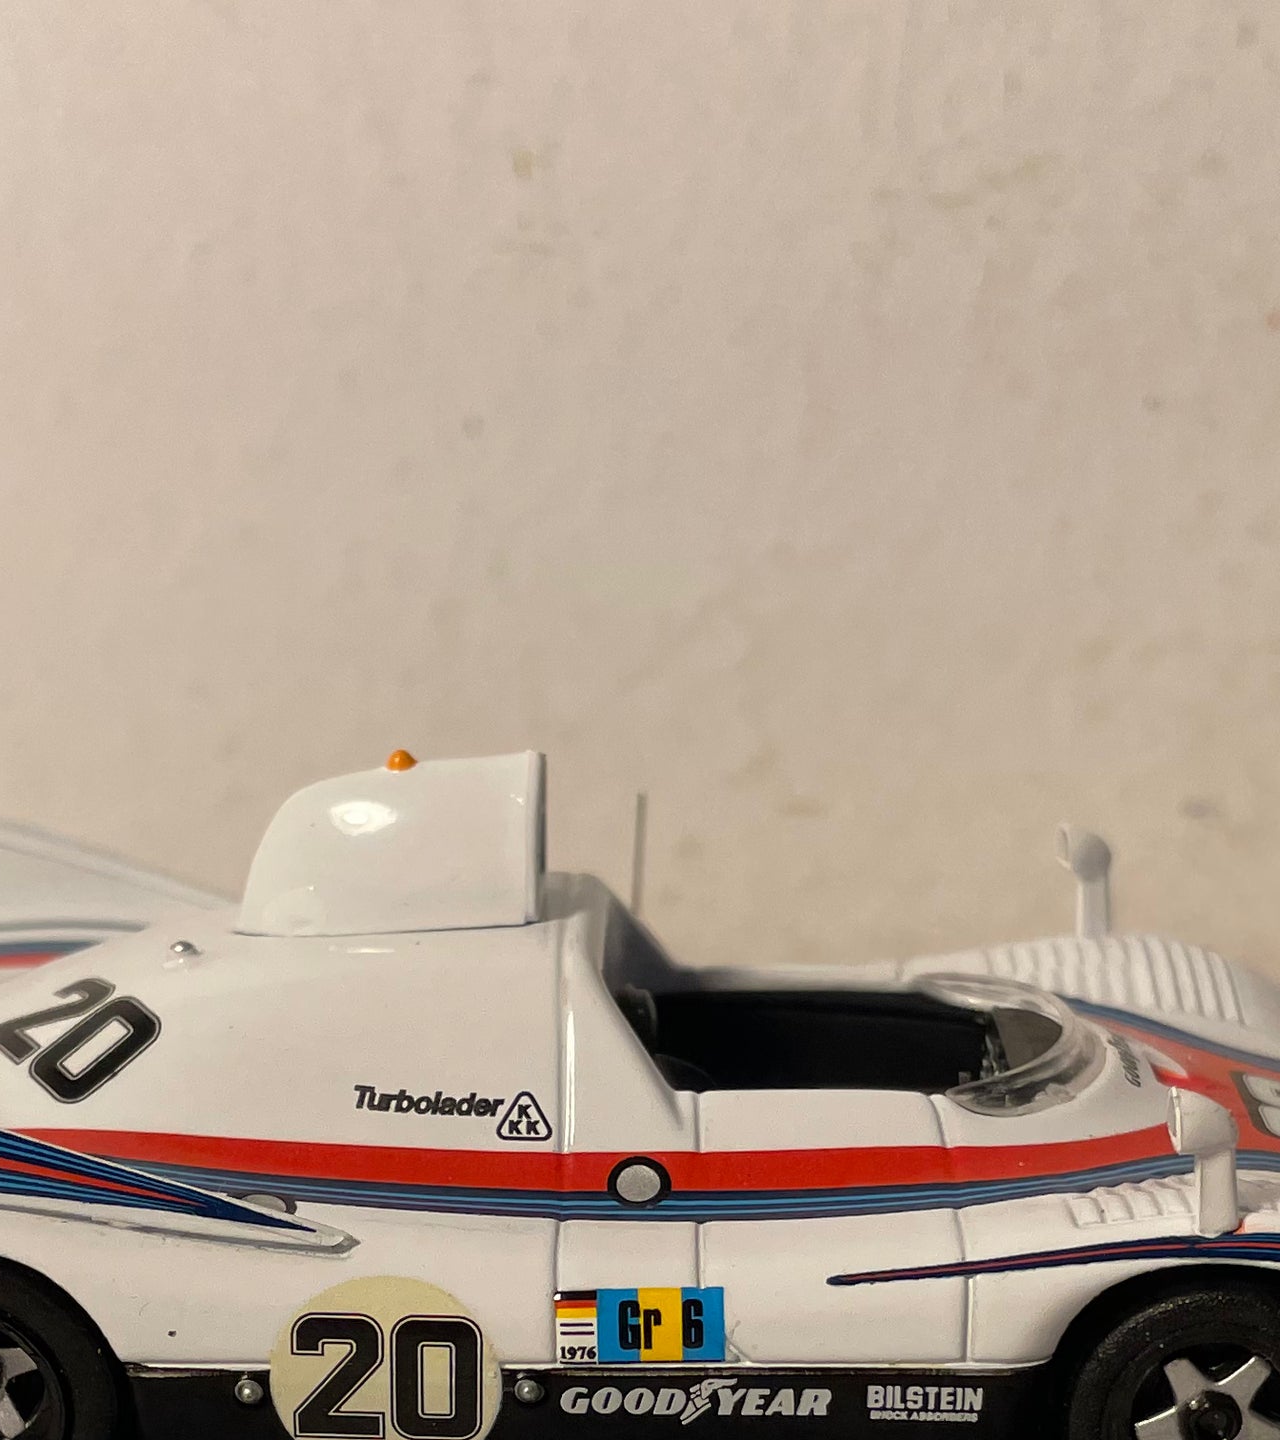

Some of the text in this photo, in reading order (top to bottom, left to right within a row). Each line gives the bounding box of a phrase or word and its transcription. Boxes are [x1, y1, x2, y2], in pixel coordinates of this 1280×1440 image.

[354, 1085, 503, 1118] Turbolader
[618, 1299, 704, 1350] Gr 6
[560, 1345, 597, 1360] 1976
[290, 1312, 483, 1440] 20
[866, 1385, 984, 1411] BILSTEIN
